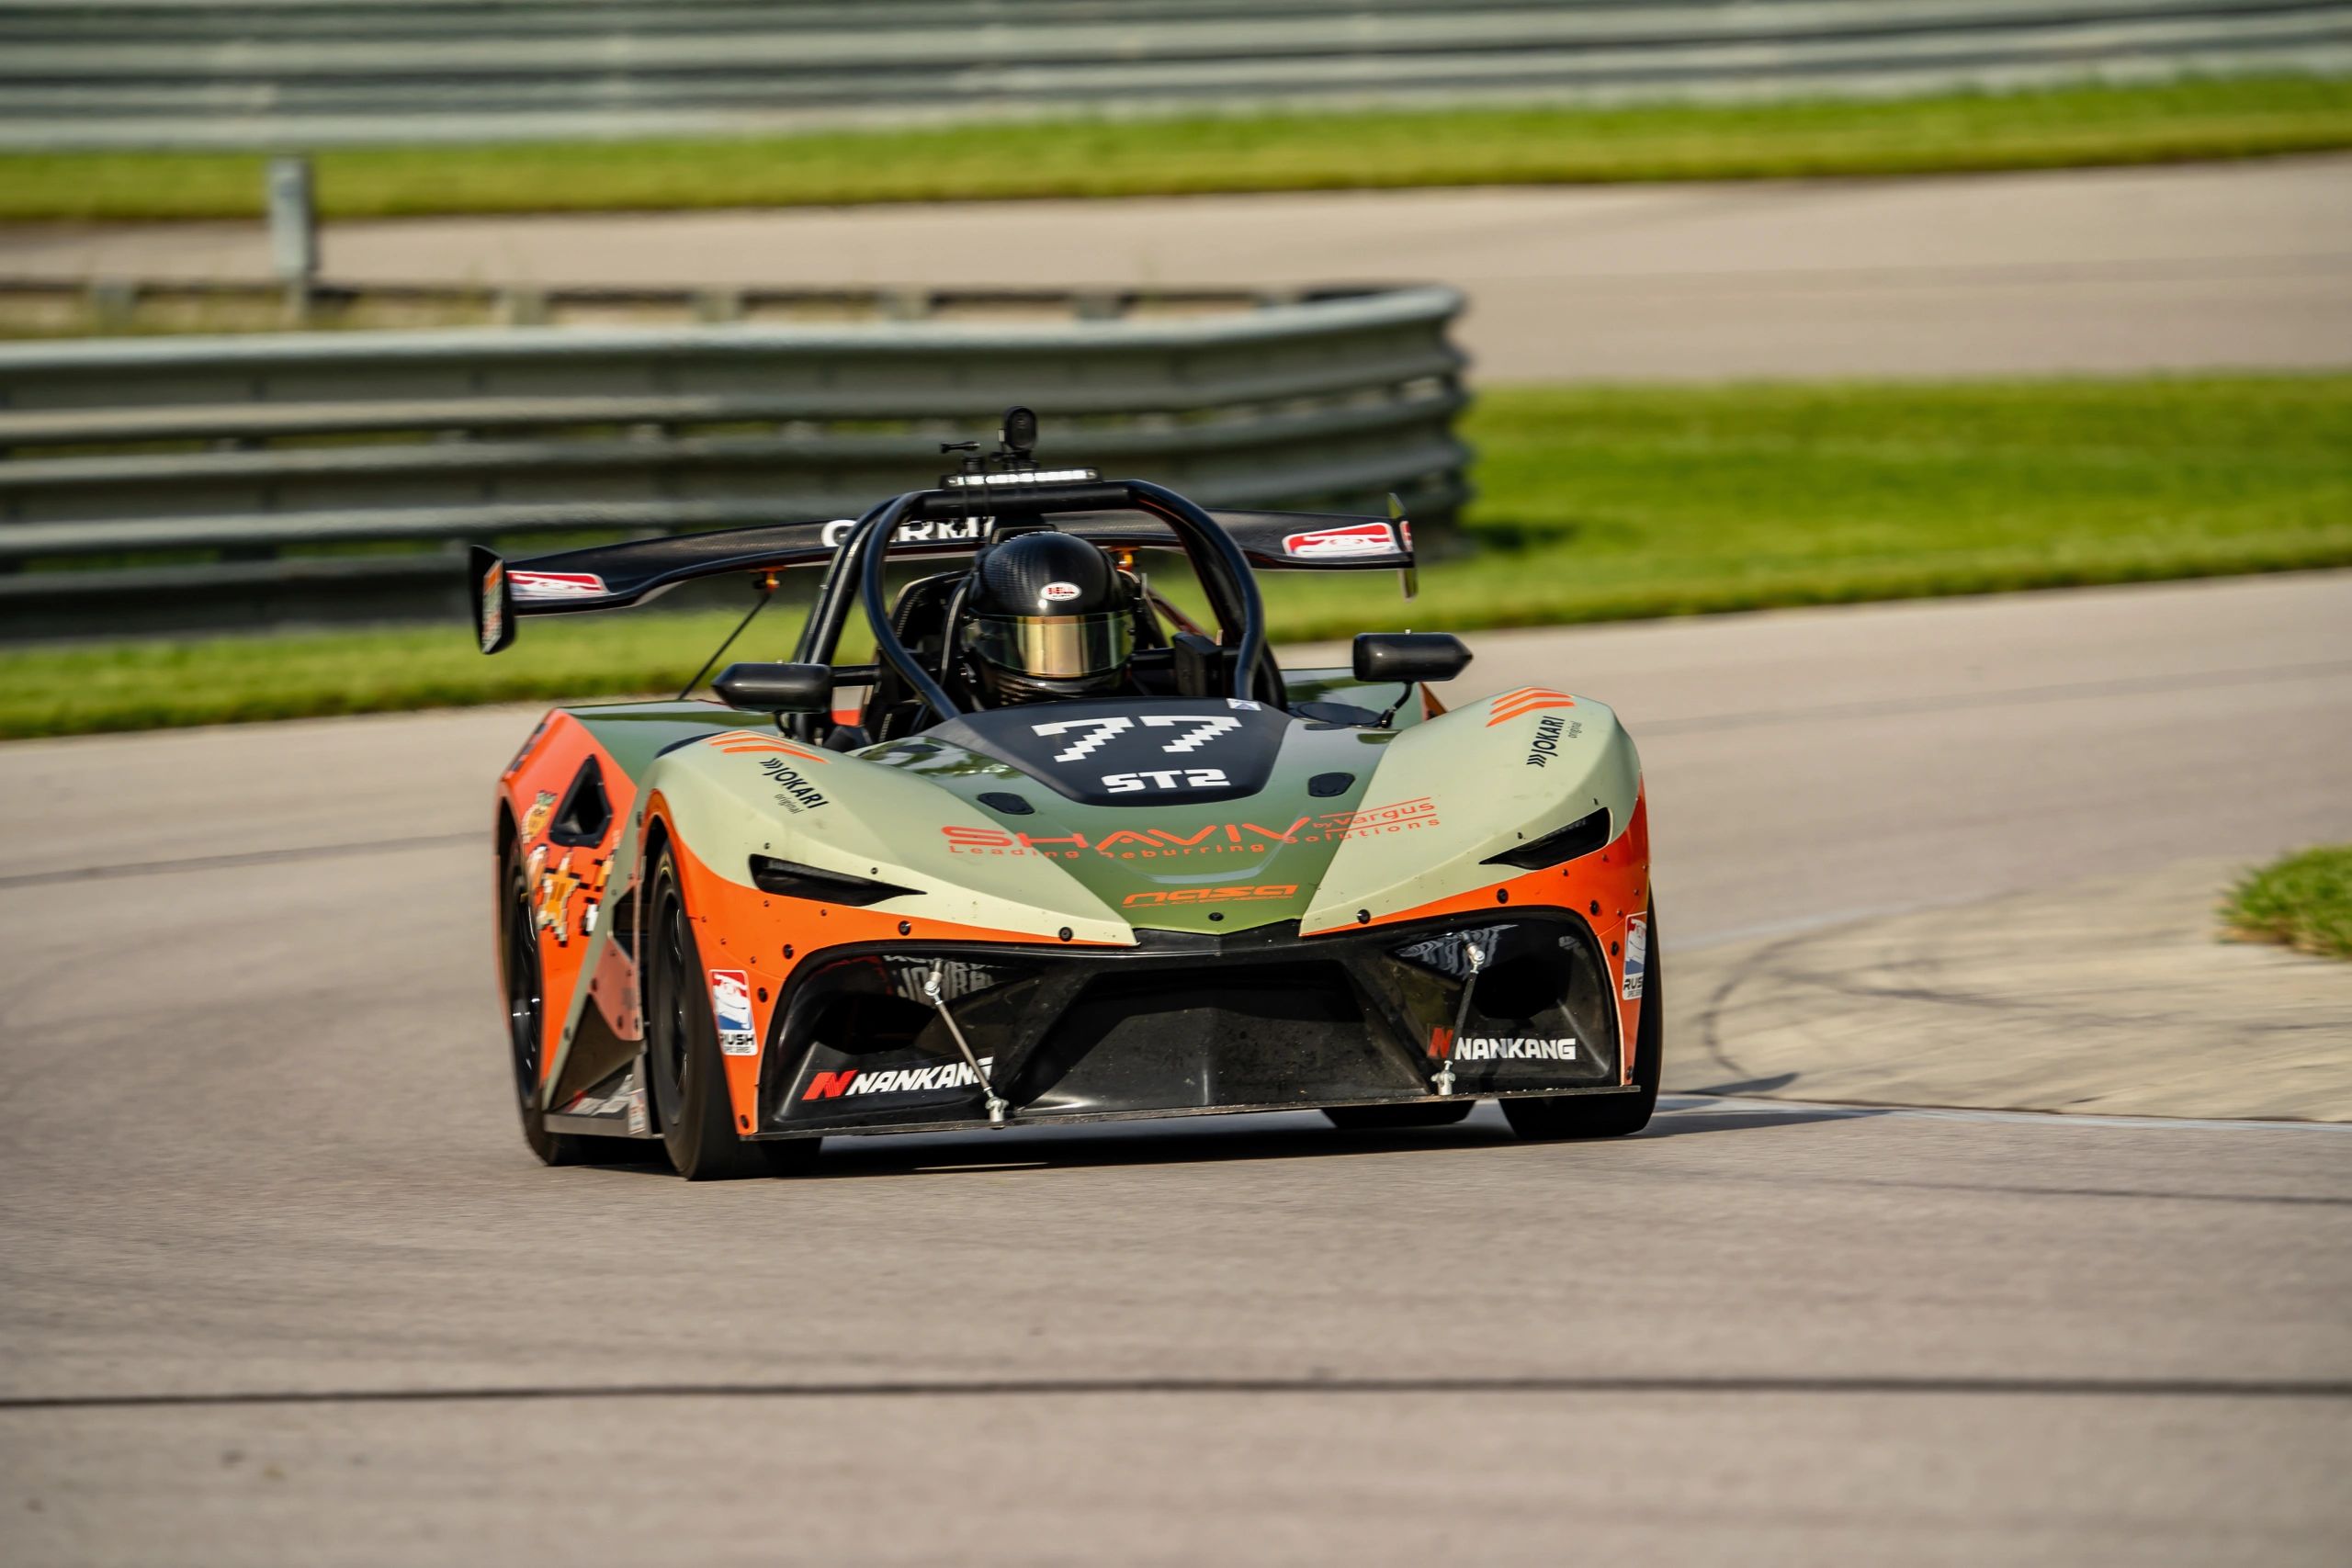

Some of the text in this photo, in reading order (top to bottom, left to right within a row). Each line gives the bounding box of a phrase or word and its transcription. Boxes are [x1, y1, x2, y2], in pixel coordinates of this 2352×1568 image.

[1031, 716, 1242, 762] 77
[1531, 716, 1566, 757] JOKARI
[762, 767, 830, 808] JOKARI
[1102, 768, 1231, 794] ST2
[941, 817, 1311, 851] SHAVIV
[949, 846, 1080, 860] Leading
[1283, 818, 1441, 844] Solutions
[1123, 885, 1299, 905] nasa
[1454, 1037, 1577, 1061] NANKANG
[845, 1056, 994, 1096] NANKANG
